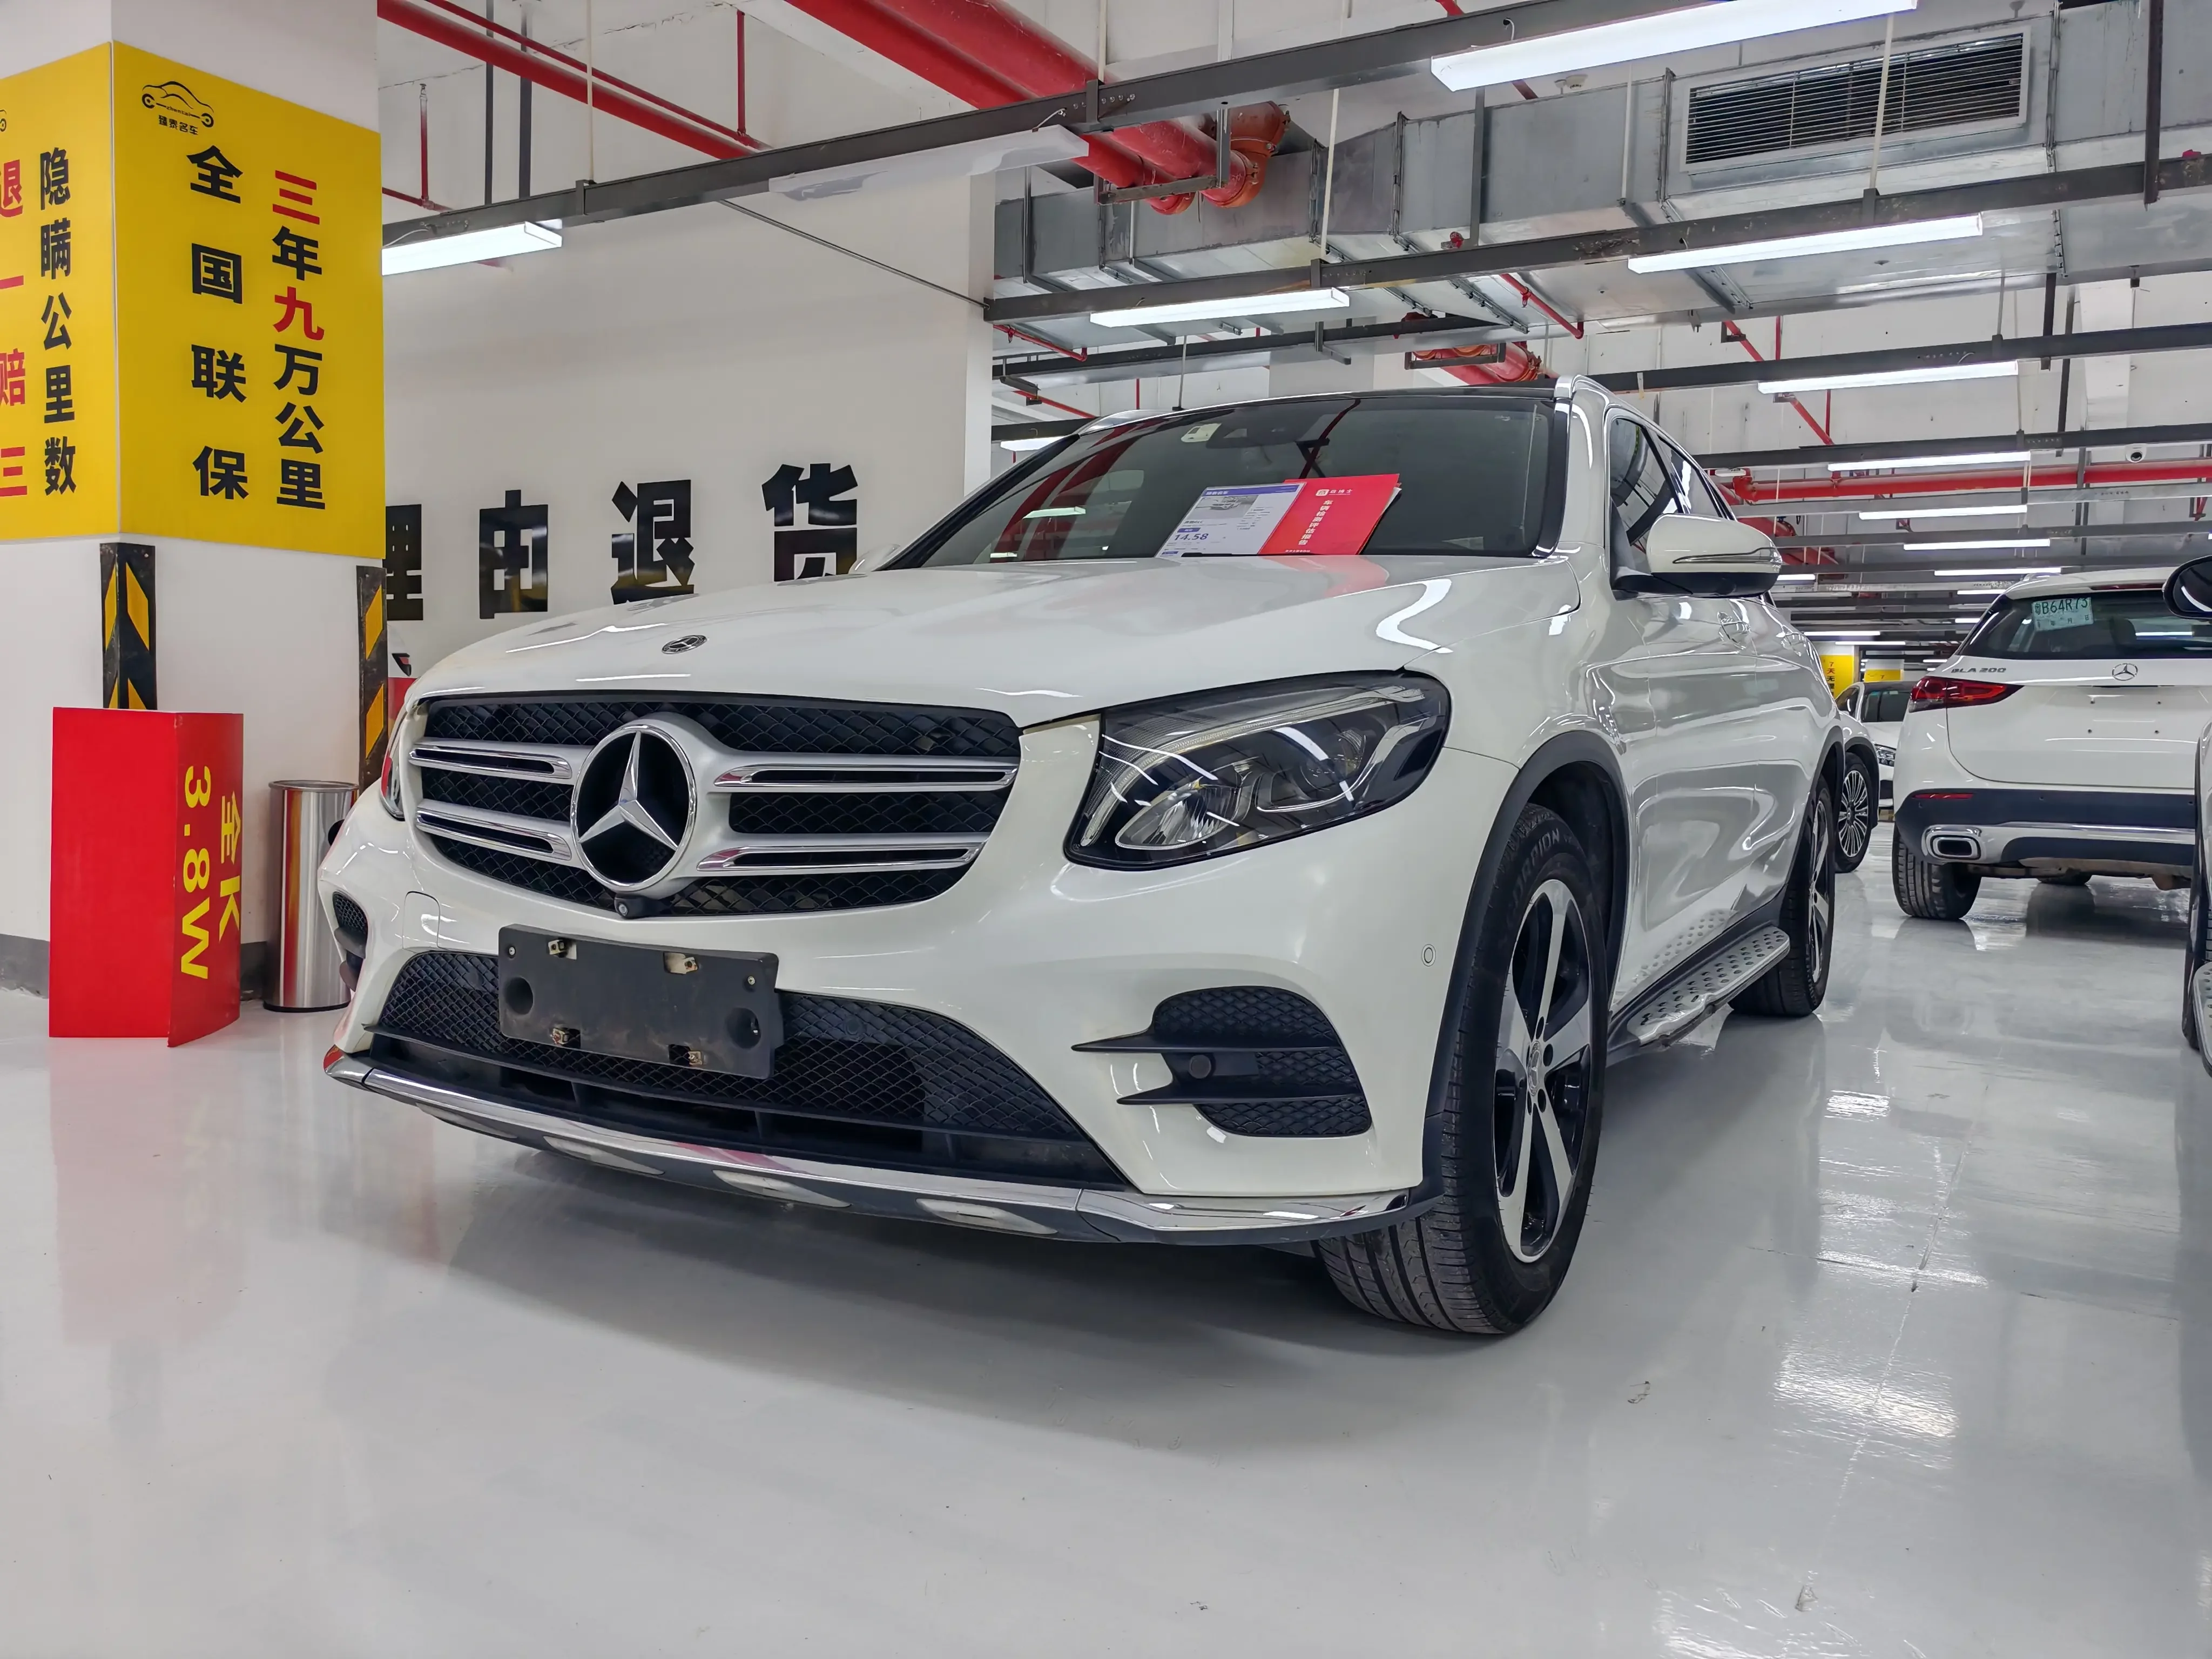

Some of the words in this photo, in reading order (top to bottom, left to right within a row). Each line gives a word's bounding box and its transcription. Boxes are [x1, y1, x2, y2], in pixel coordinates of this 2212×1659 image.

[0, 159, 28, 498] 退一赔三
[40, 146, 77, 496] 隐瞒公里数
[186, 145, 249, 500] 全国联保
[272, 170, 326, 510] 三年九万公里
[1826, 662, 1836, 696] 7天无
[180, 765, 212, 980] 3.8W
